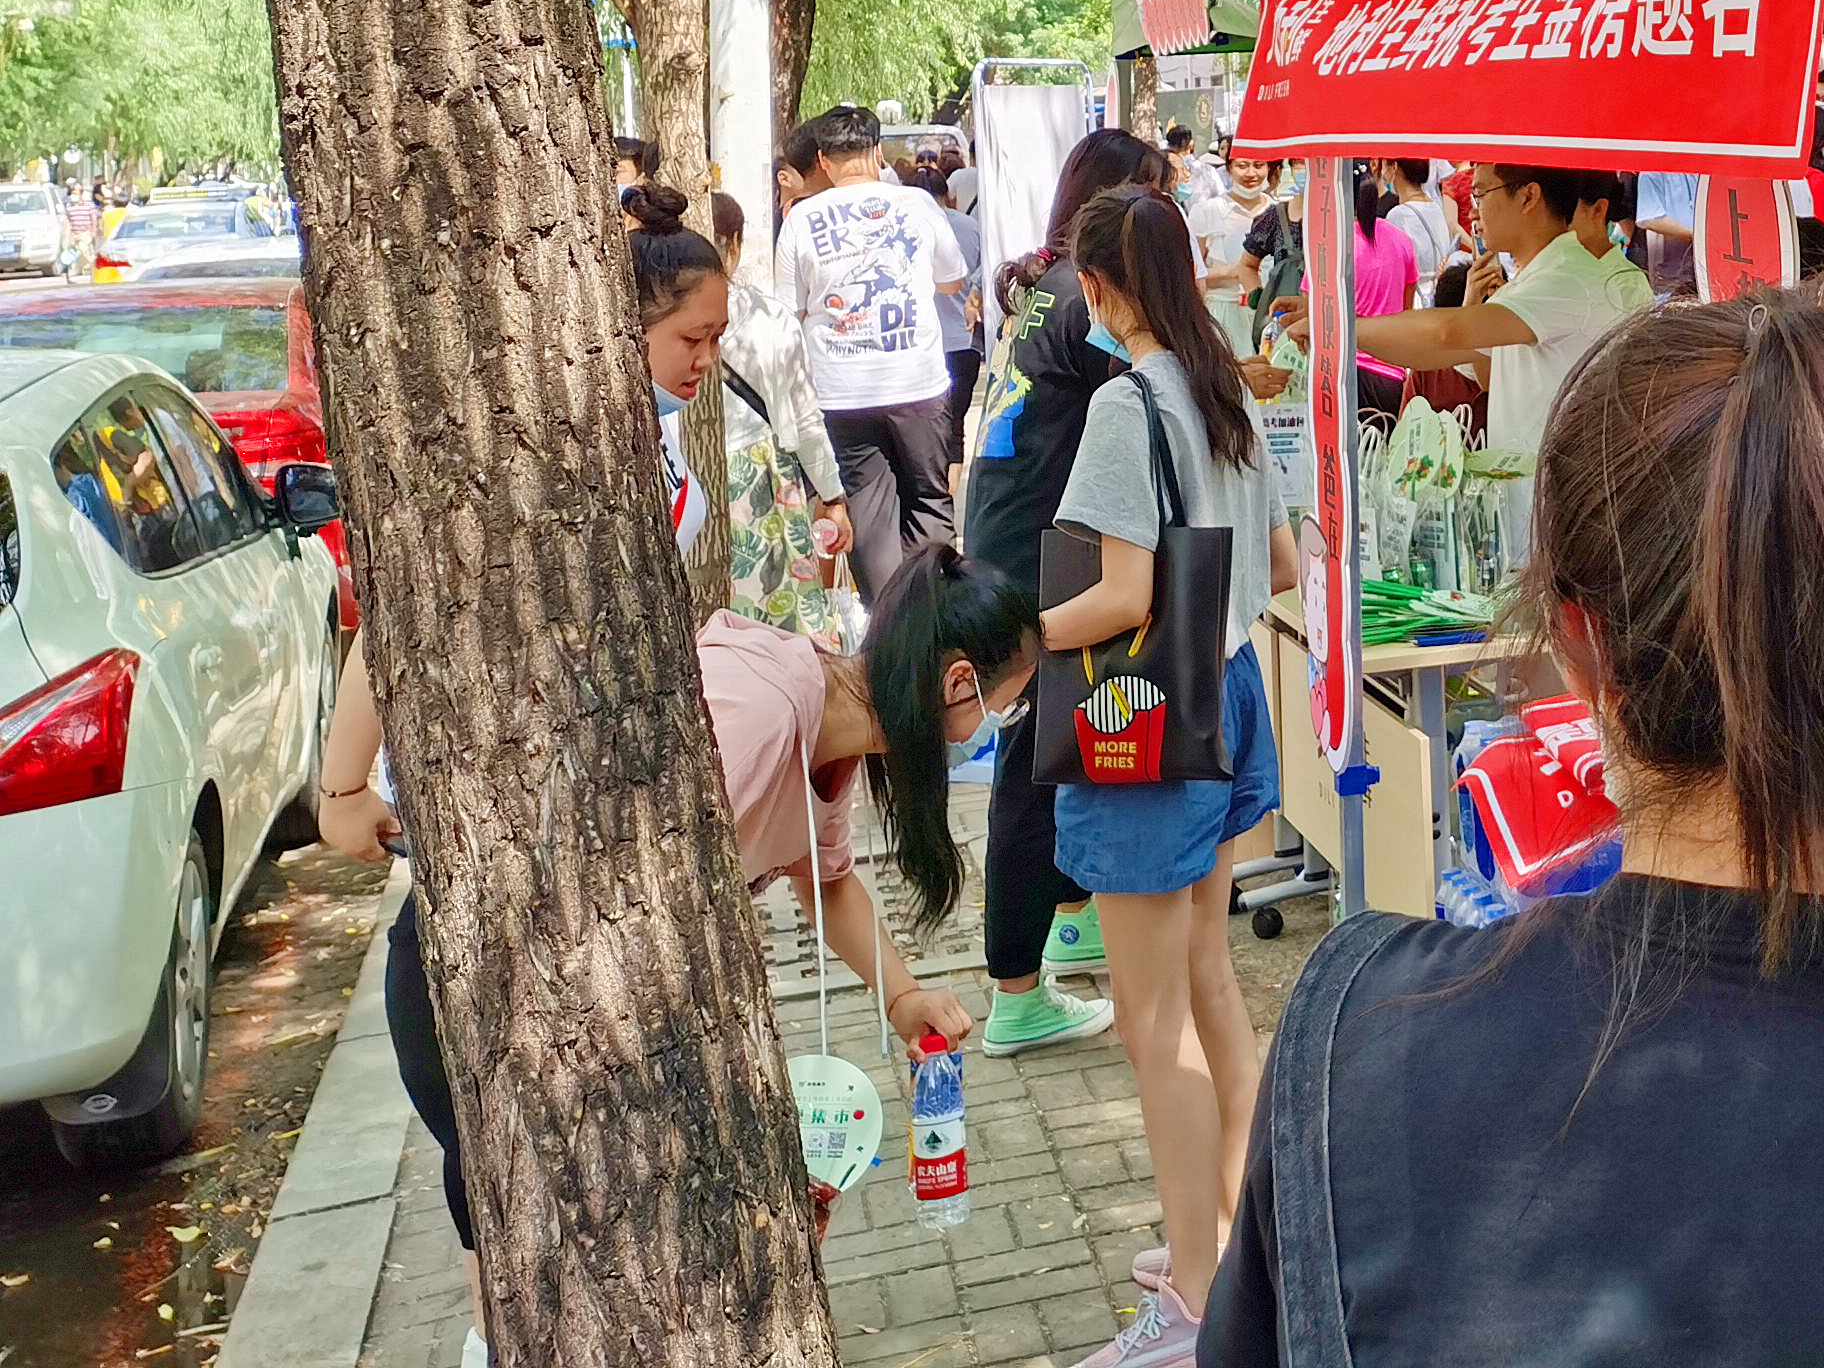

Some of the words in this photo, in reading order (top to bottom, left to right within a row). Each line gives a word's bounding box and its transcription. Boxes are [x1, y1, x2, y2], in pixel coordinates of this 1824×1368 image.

[806, 200, 862, 234] BIK
[813, 228, 857, 258] ER
[880, 299, 917, 333] DE
[1094, 741, 1137, 754] MORE
[1094, 756, 1135, 769] FRIES
